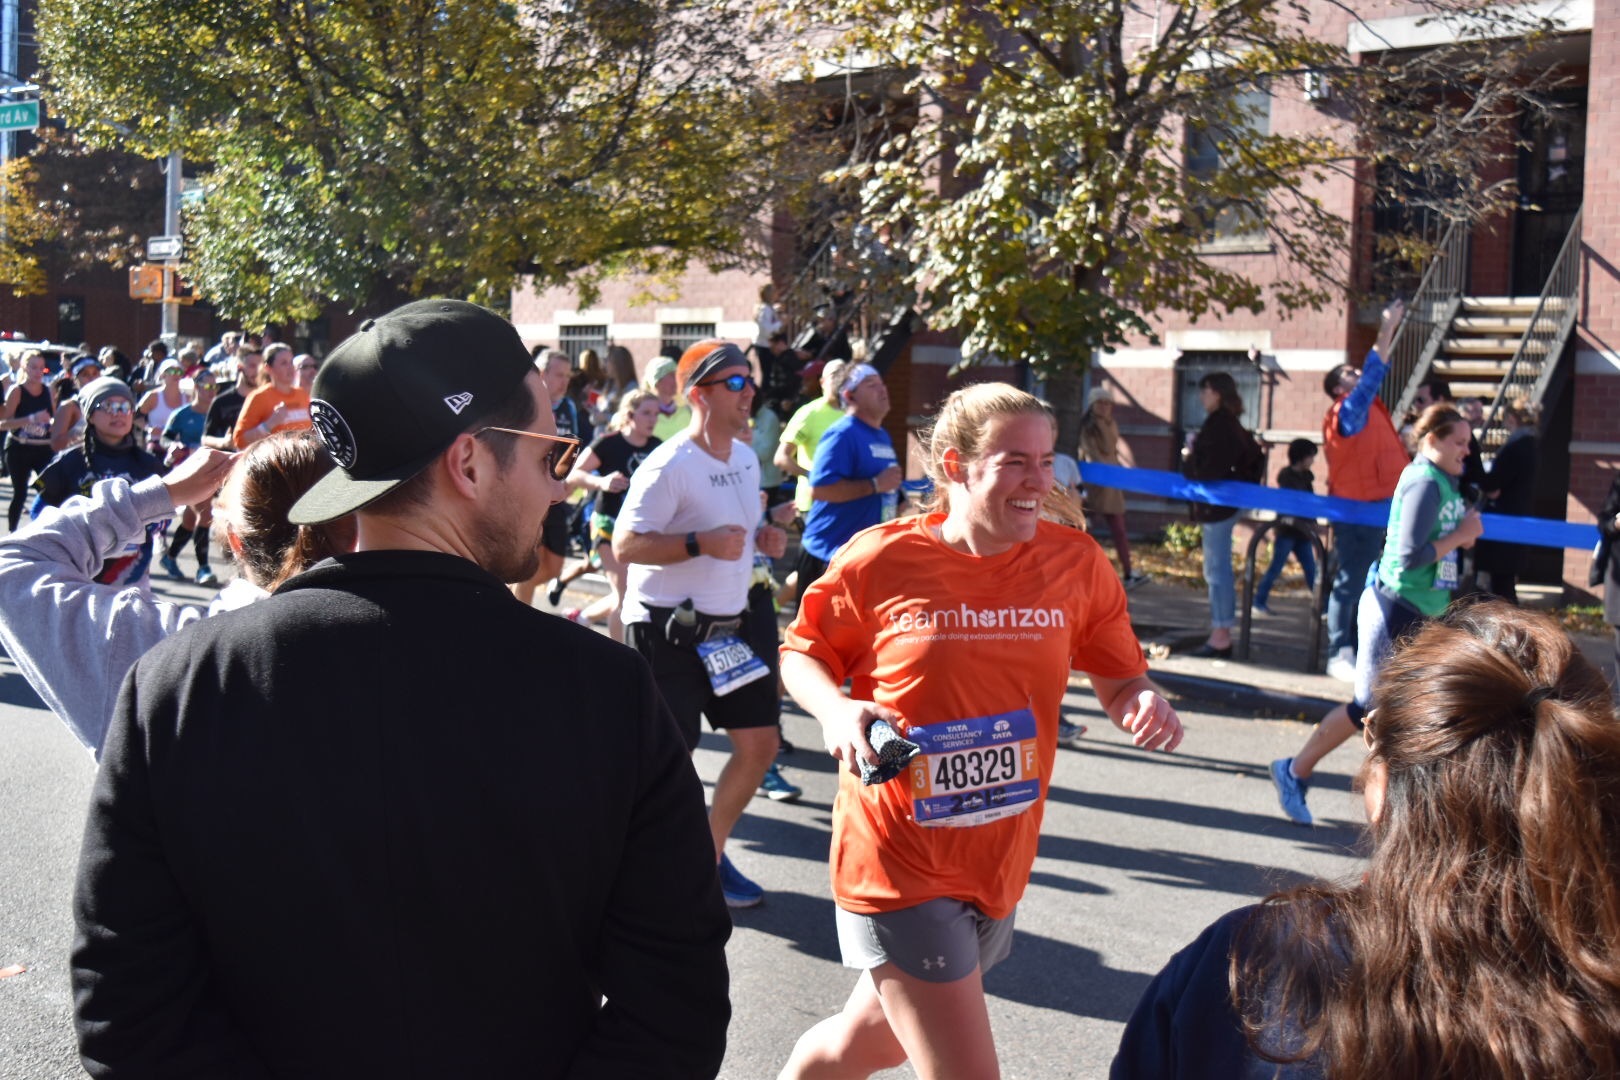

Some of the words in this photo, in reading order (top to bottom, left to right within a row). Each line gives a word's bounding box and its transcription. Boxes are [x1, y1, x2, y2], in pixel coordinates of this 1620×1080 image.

[14, 108, 29, 123] Av
[708, 471, 743, 487] MATT
[948, 632, 969, 642] doing
[969, 632, 1019, 642] extraordinary
[946, 724, 968, 732] TATA
[932, 730, 983, 743] CONSULTANCY
[991, 731, 1013, 740] TATA
[942, 739, 974, 749] SERVICES
[915, 769, 926, 789] 3
[935, 746, 1016, 791] 48329
[1025, 751, 1034, 772] F
